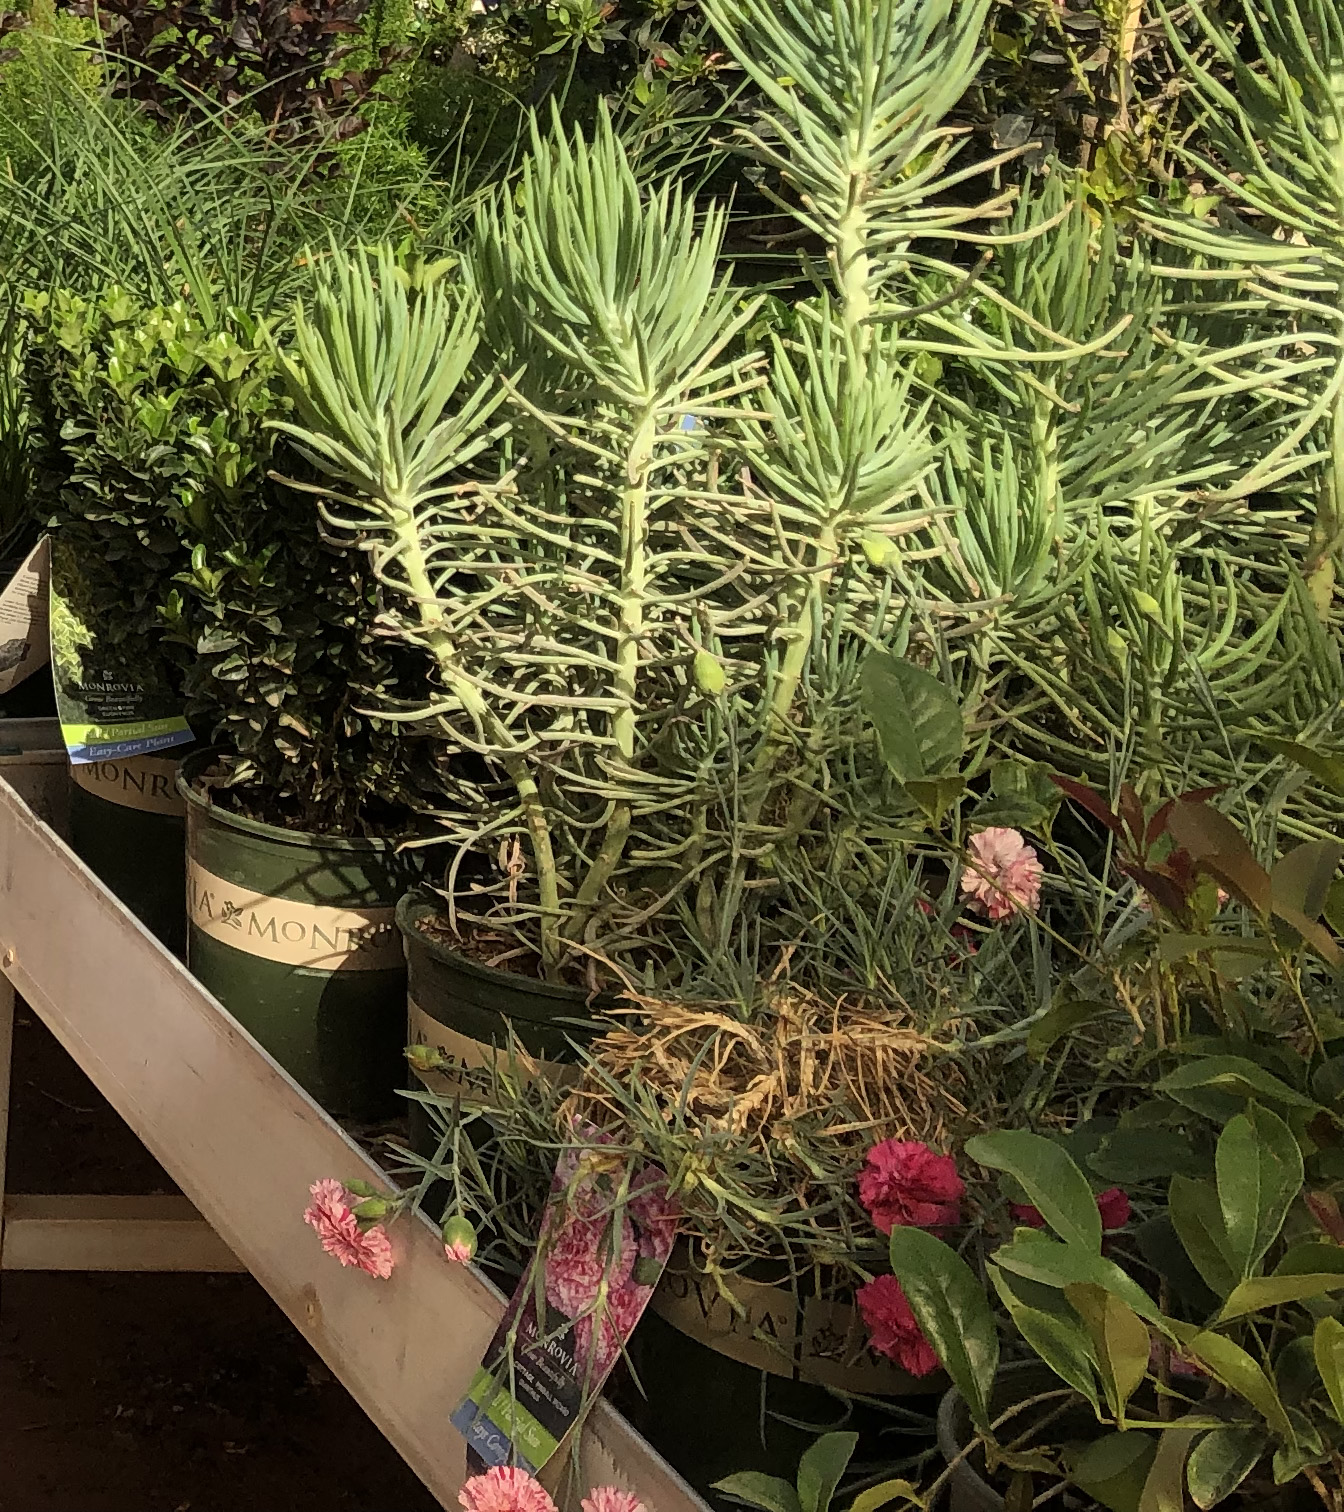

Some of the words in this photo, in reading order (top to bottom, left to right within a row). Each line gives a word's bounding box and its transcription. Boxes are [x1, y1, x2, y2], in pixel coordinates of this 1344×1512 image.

[77, 679, 144, 695] MONROVIA
[112, 724, 145, 738] Partial
[89, 741, 142, 758] Easy-Care
[146, 736, 175, 748] Plant
[81, 761, 180, 800] MONR
